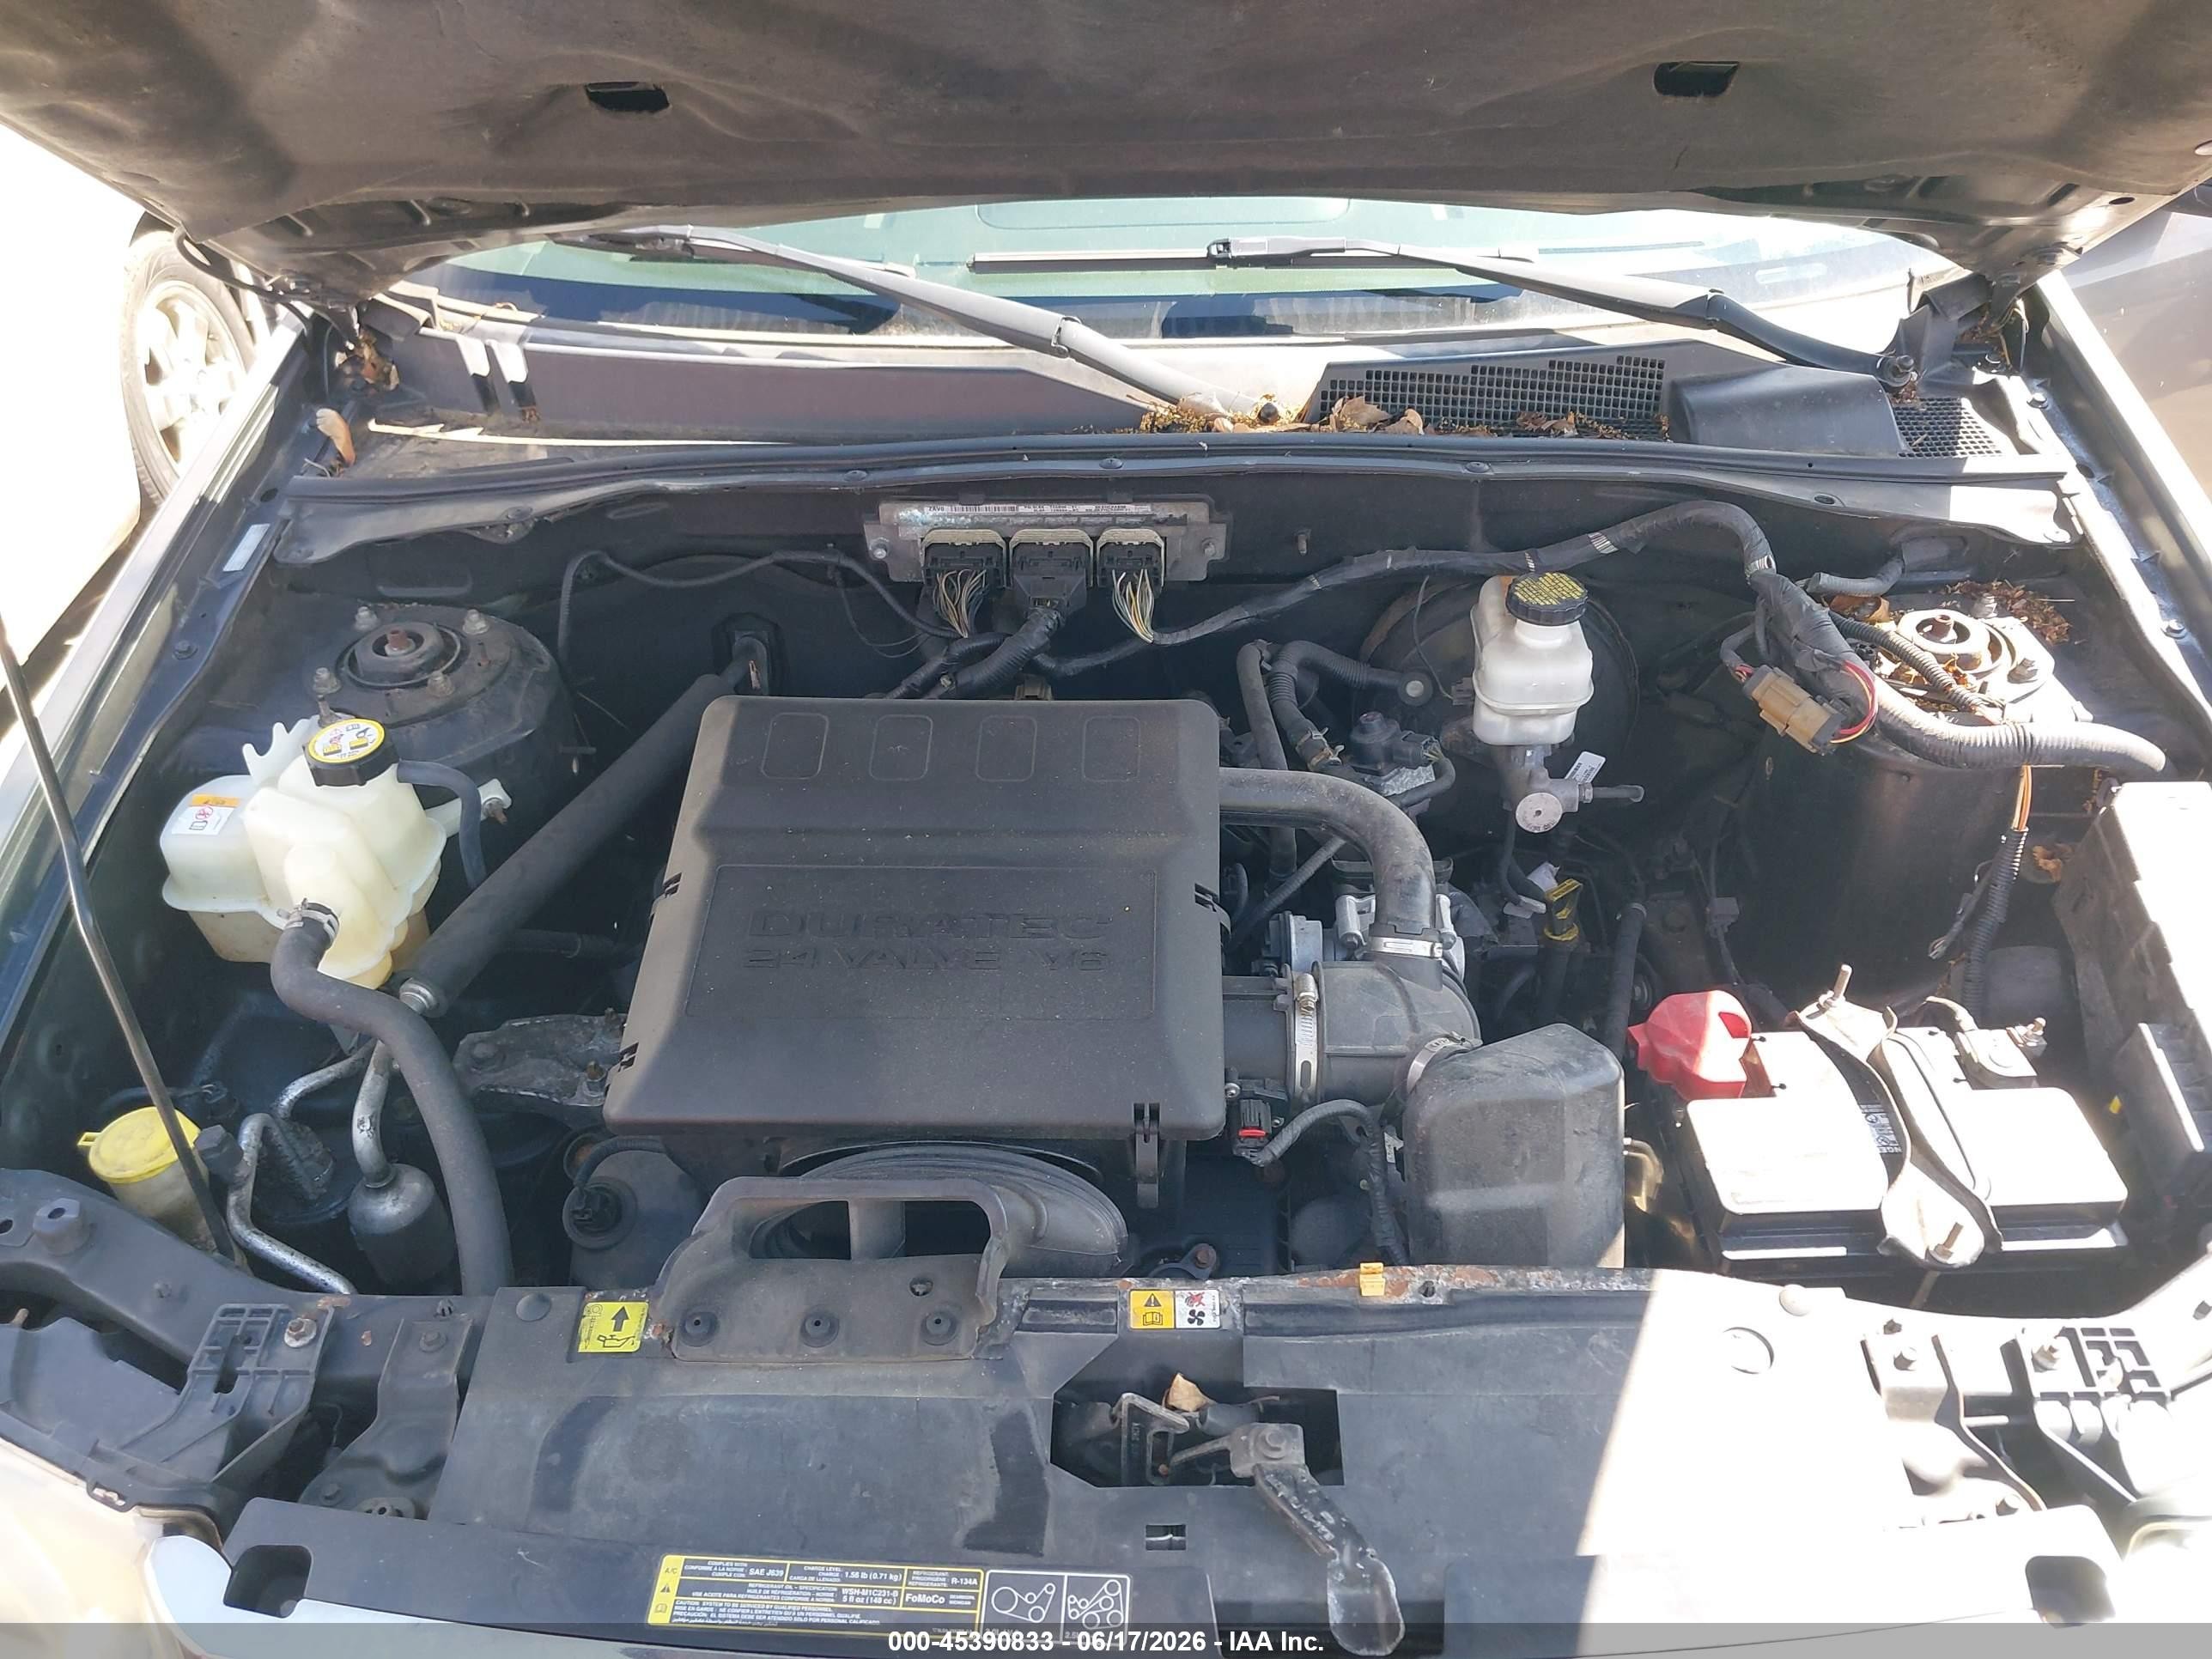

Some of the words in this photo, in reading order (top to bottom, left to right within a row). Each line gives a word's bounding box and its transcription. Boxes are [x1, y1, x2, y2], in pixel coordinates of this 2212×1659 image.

[748, 912, 1113, 939] DURATEC
[744, 949, 817, 969] 24
[834, 949, 1001, 971] VALVE
[1029, 949, 1109, 971] V6
[889, 1573, 902, 1582] kg)
[905, 1593, 945, 1604] FoMoCo
